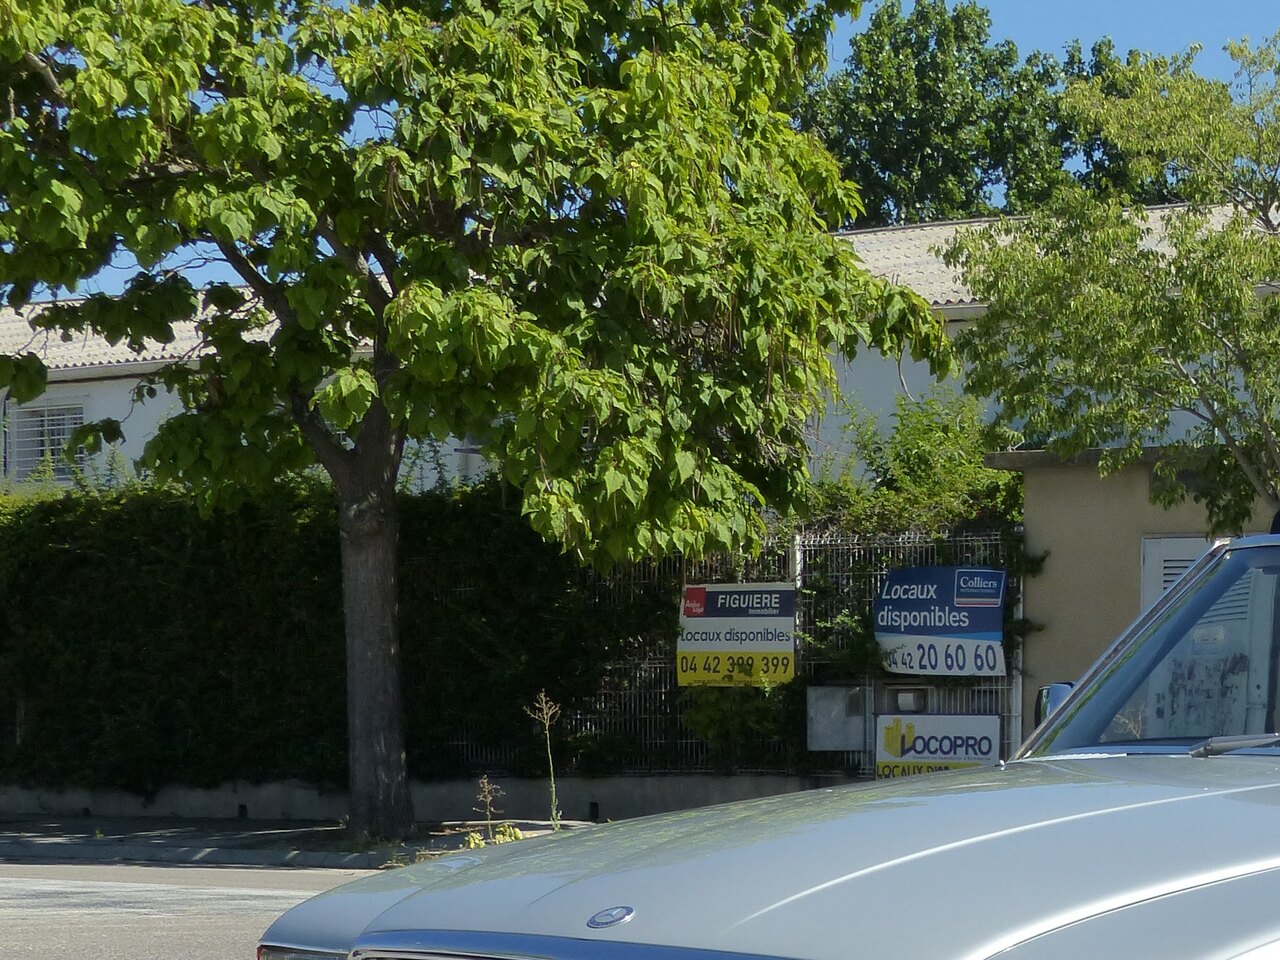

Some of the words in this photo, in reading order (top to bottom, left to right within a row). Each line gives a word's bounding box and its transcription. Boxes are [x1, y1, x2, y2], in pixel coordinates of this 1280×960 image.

[881, 580, 937, 600] Locaux
[960, 576, 998, 589] Colliers
[717, 594, 780, 608] FIGUIERE
[878, 606, 970, 631] disponibles
[724, 628, 791, 645] disponibles
[680, 655, 697, 674] 04
[703, 655, 720, 674] 42
[761, 656, 790, 674] 399
[901, 652, 914, 670] 42
[917, 643, 939, 671] 20
[944, 644, 966, 671] 60
[974, 644, 997, 671] 60
[902, 732, 993, 758] LOCOPRO
